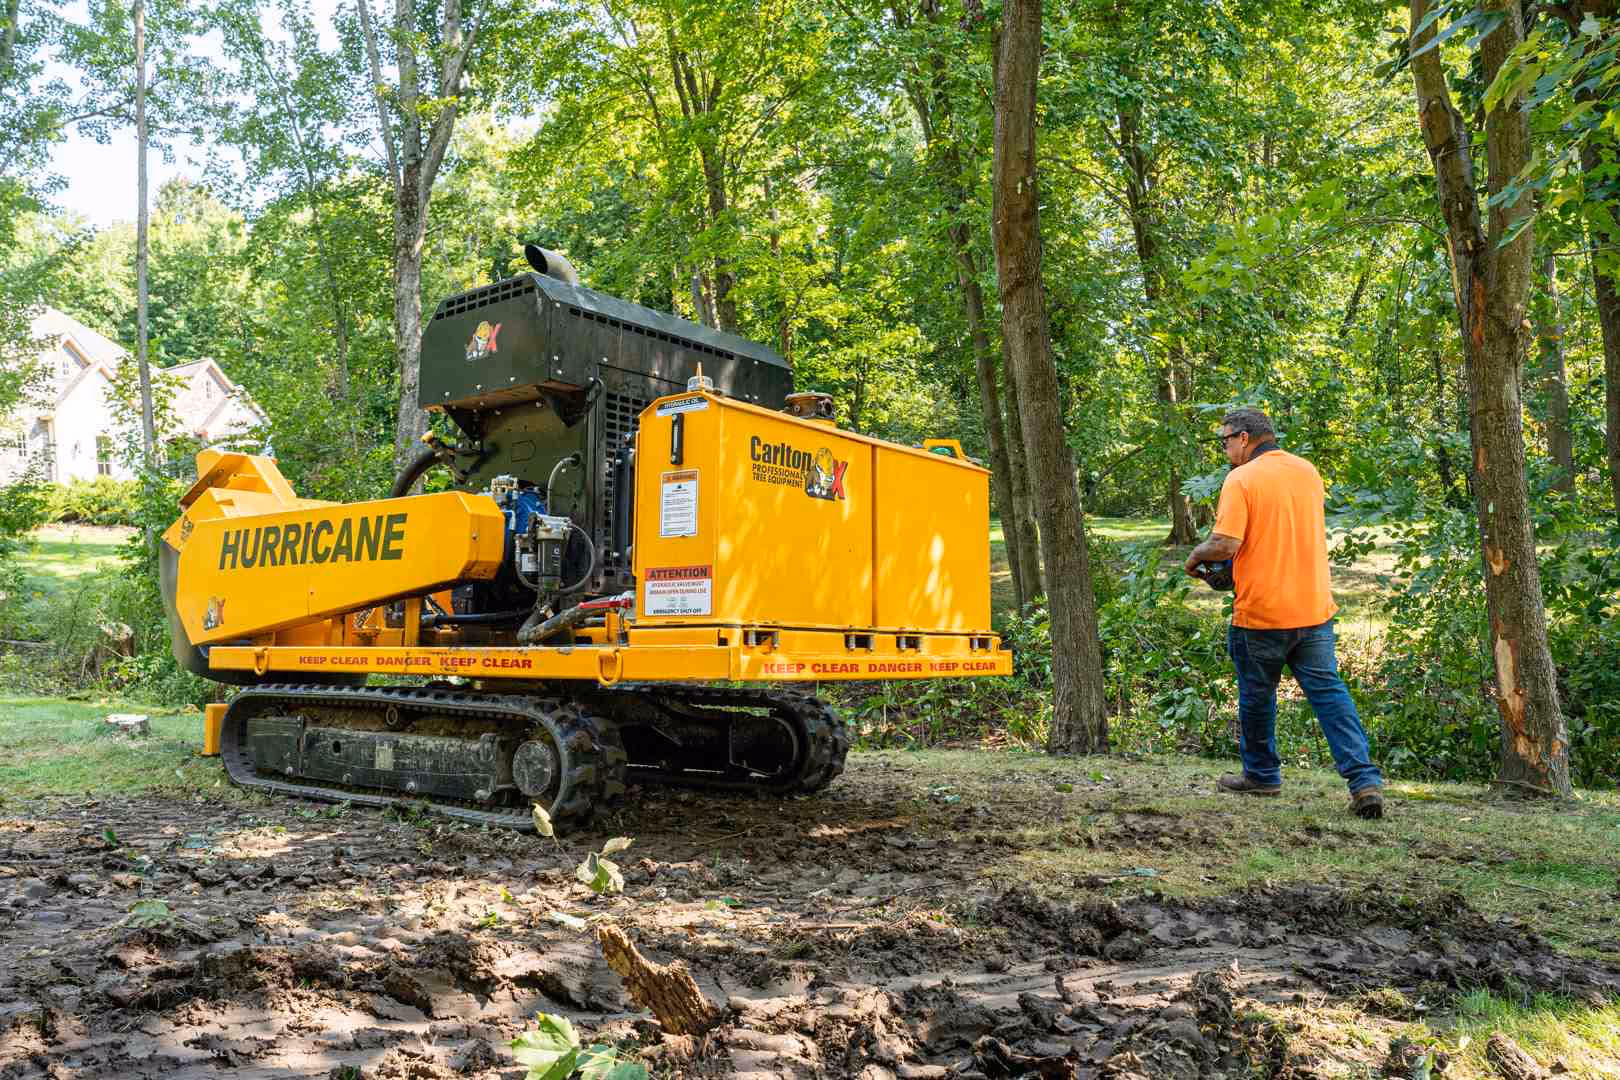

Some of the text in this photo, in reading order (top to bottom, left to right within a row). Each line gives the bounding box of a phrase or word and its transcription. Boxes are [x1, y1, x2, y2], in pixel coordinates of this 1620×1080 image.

[751, 435, 812, 472] Carlton
[752, 463, 804, 481] PROFESSIONAL
[752, 472, 803, 489] TREE EQUIPMENT
[218, 512, 408, 570] HURRICANE
[650, 567, 708, 579] ATTENTION
[299, 655, 533, 669] KEEP CLEAR DANGER KEEP CLEAR
[763, 661, 997, 674] KEEP CLEAR DANGER KEEP CLEAR
